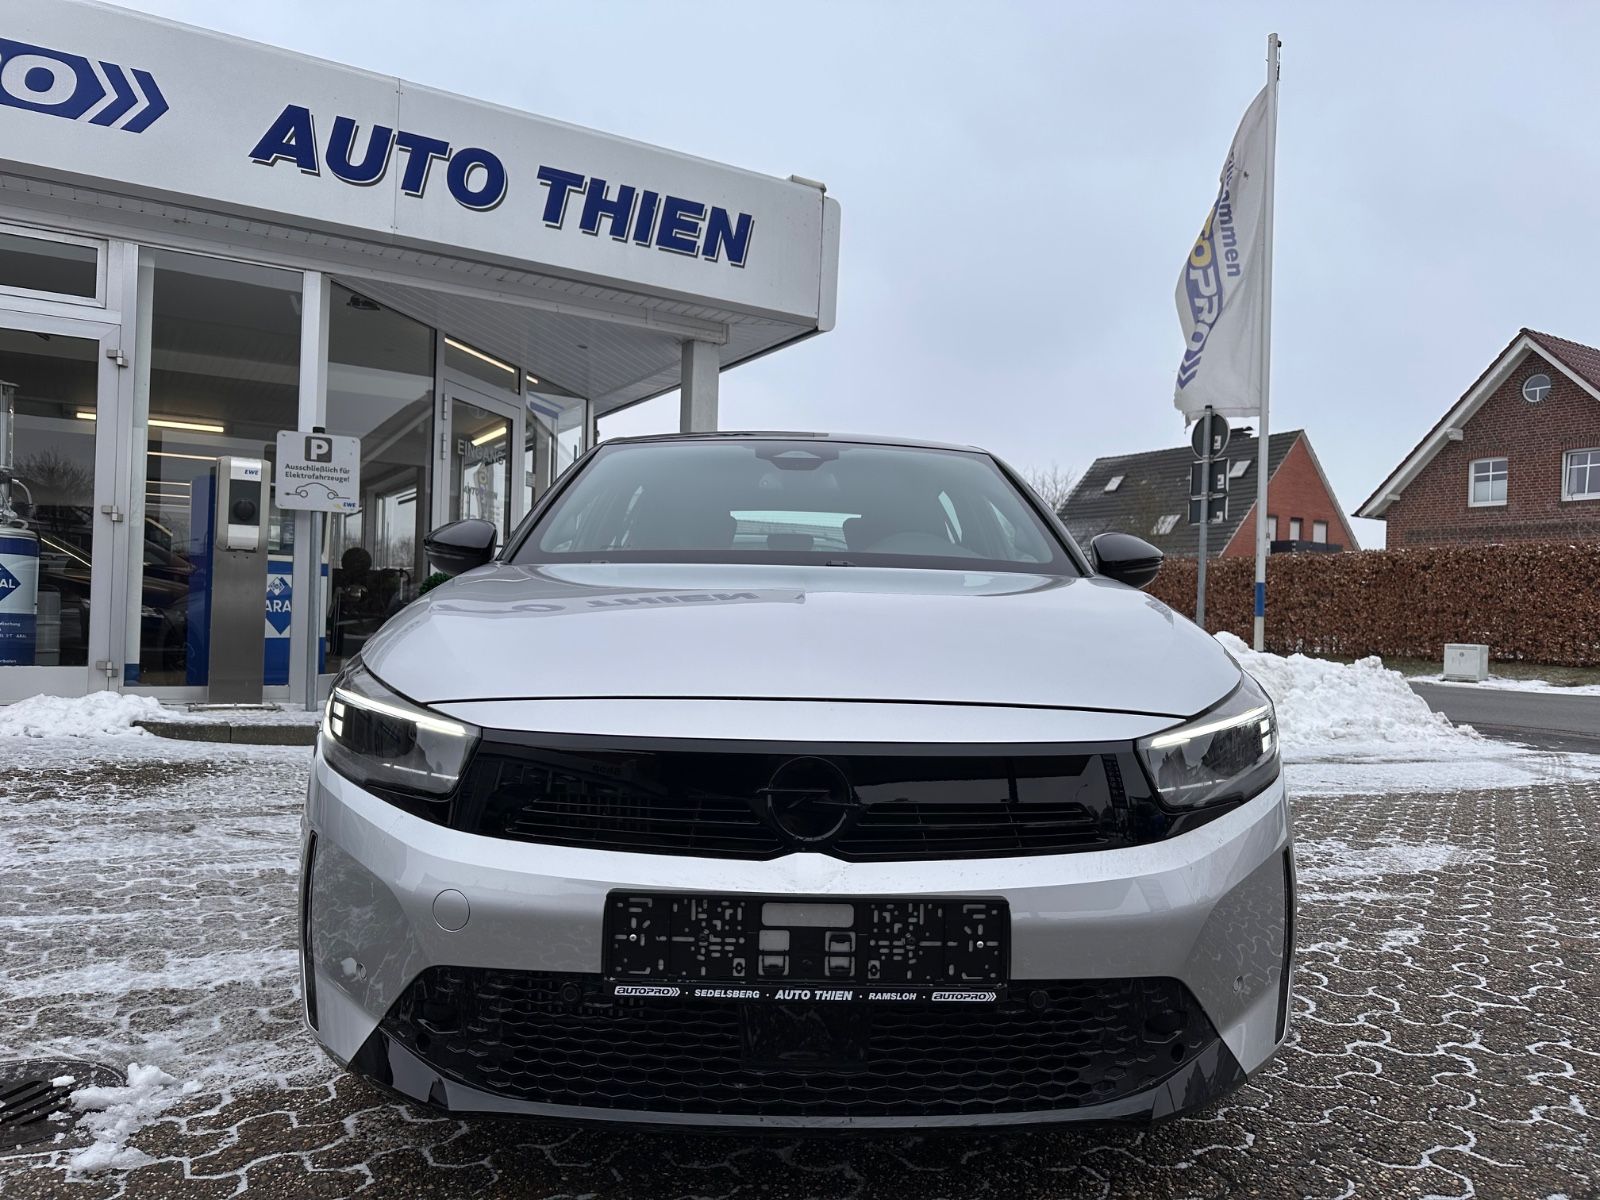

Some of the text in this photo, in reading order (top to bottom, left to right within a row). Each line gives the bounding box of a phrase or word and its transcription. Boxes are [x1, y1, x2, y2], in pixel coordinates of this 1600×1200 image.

[248, 104, 755, 268] AUTO THIEN
[310, 439, 330, 461] P
[285, 463, 350, 475] Ausschließlich für
[285, 471, 350, 483] Elektrofahrzeuge!
[0, 578, 16, 589] AL
[265, 600, 291, 613] ARA
[694, 989, 761, 999] SEDELSBERG
[775, 989, 811, 1000] AUTO
[814, 990, 853, 1001] THIEN
[868, 992, 917, 1001] RAMSLOH
